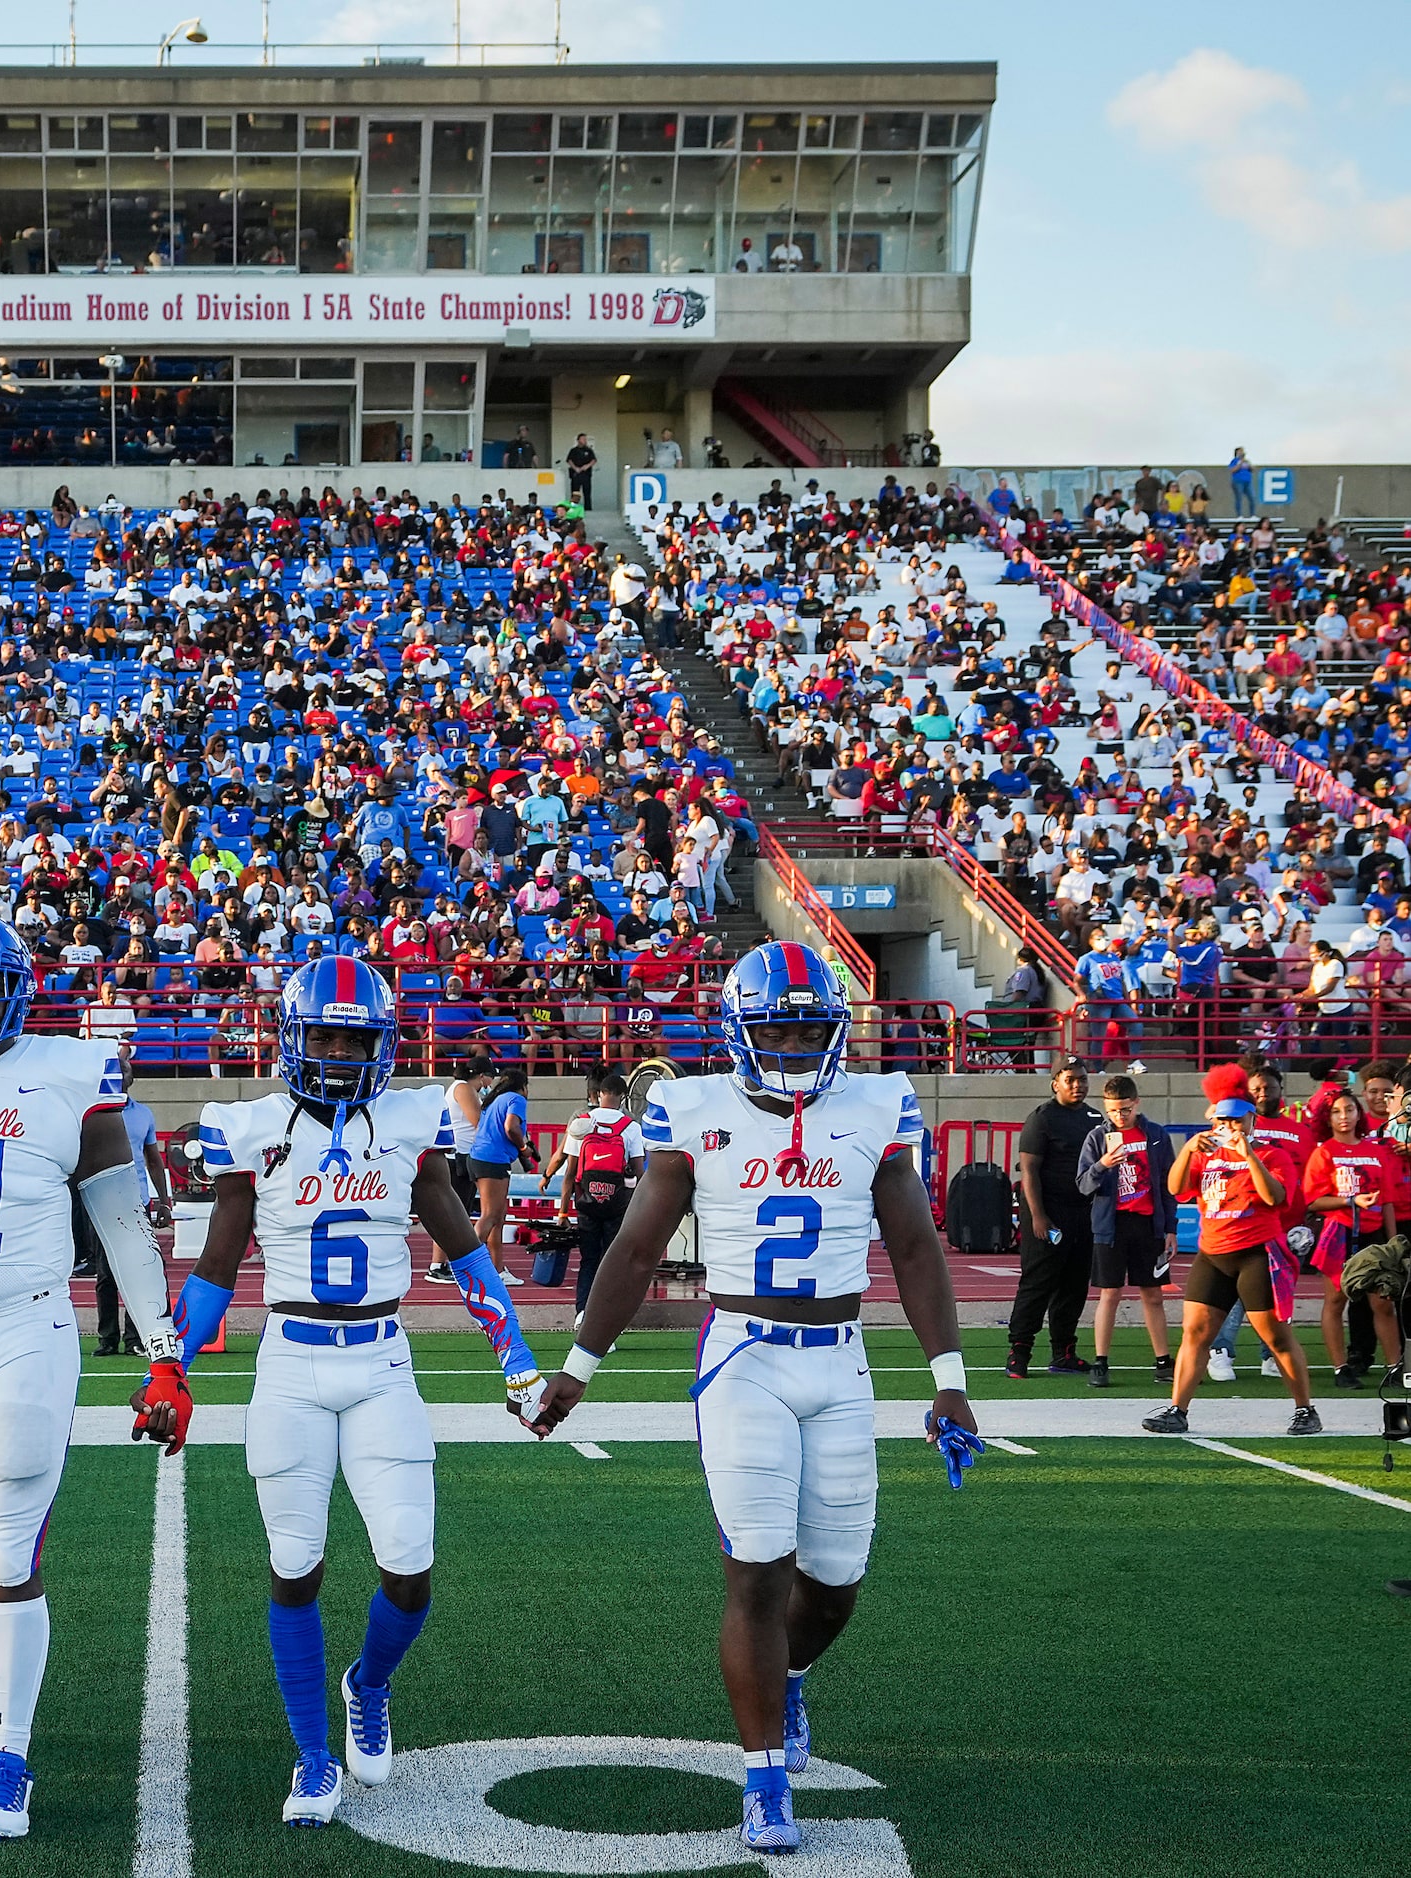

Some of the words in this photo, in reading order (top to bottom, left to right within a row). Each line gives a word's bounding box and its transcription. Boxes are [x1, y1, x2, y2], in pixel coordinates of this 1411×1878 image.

[88, 295, 147, 321] Home
[163, 295, 182, 320] of
[198, 295, 289, 321] Division
[303, 295, 312, 320] I
[324, 295, 352, 320] 5A
[370, 295, 421, 320] State
[441, 294, 570, 326] Champions!
[589, 294, 643, 320] 1998
[635, 475, 662, 504] D
[1263, 470, 1288, 502] E
[228, 813, 239, 823] T
[842, 892, 856, 908] D
[332, 1005, 358, 1013] Riddell
[589, 1181, 616, 1196] SMU
[311, 1208, 371, 1304] 6
[754, 1195, 822, 1297] 2
